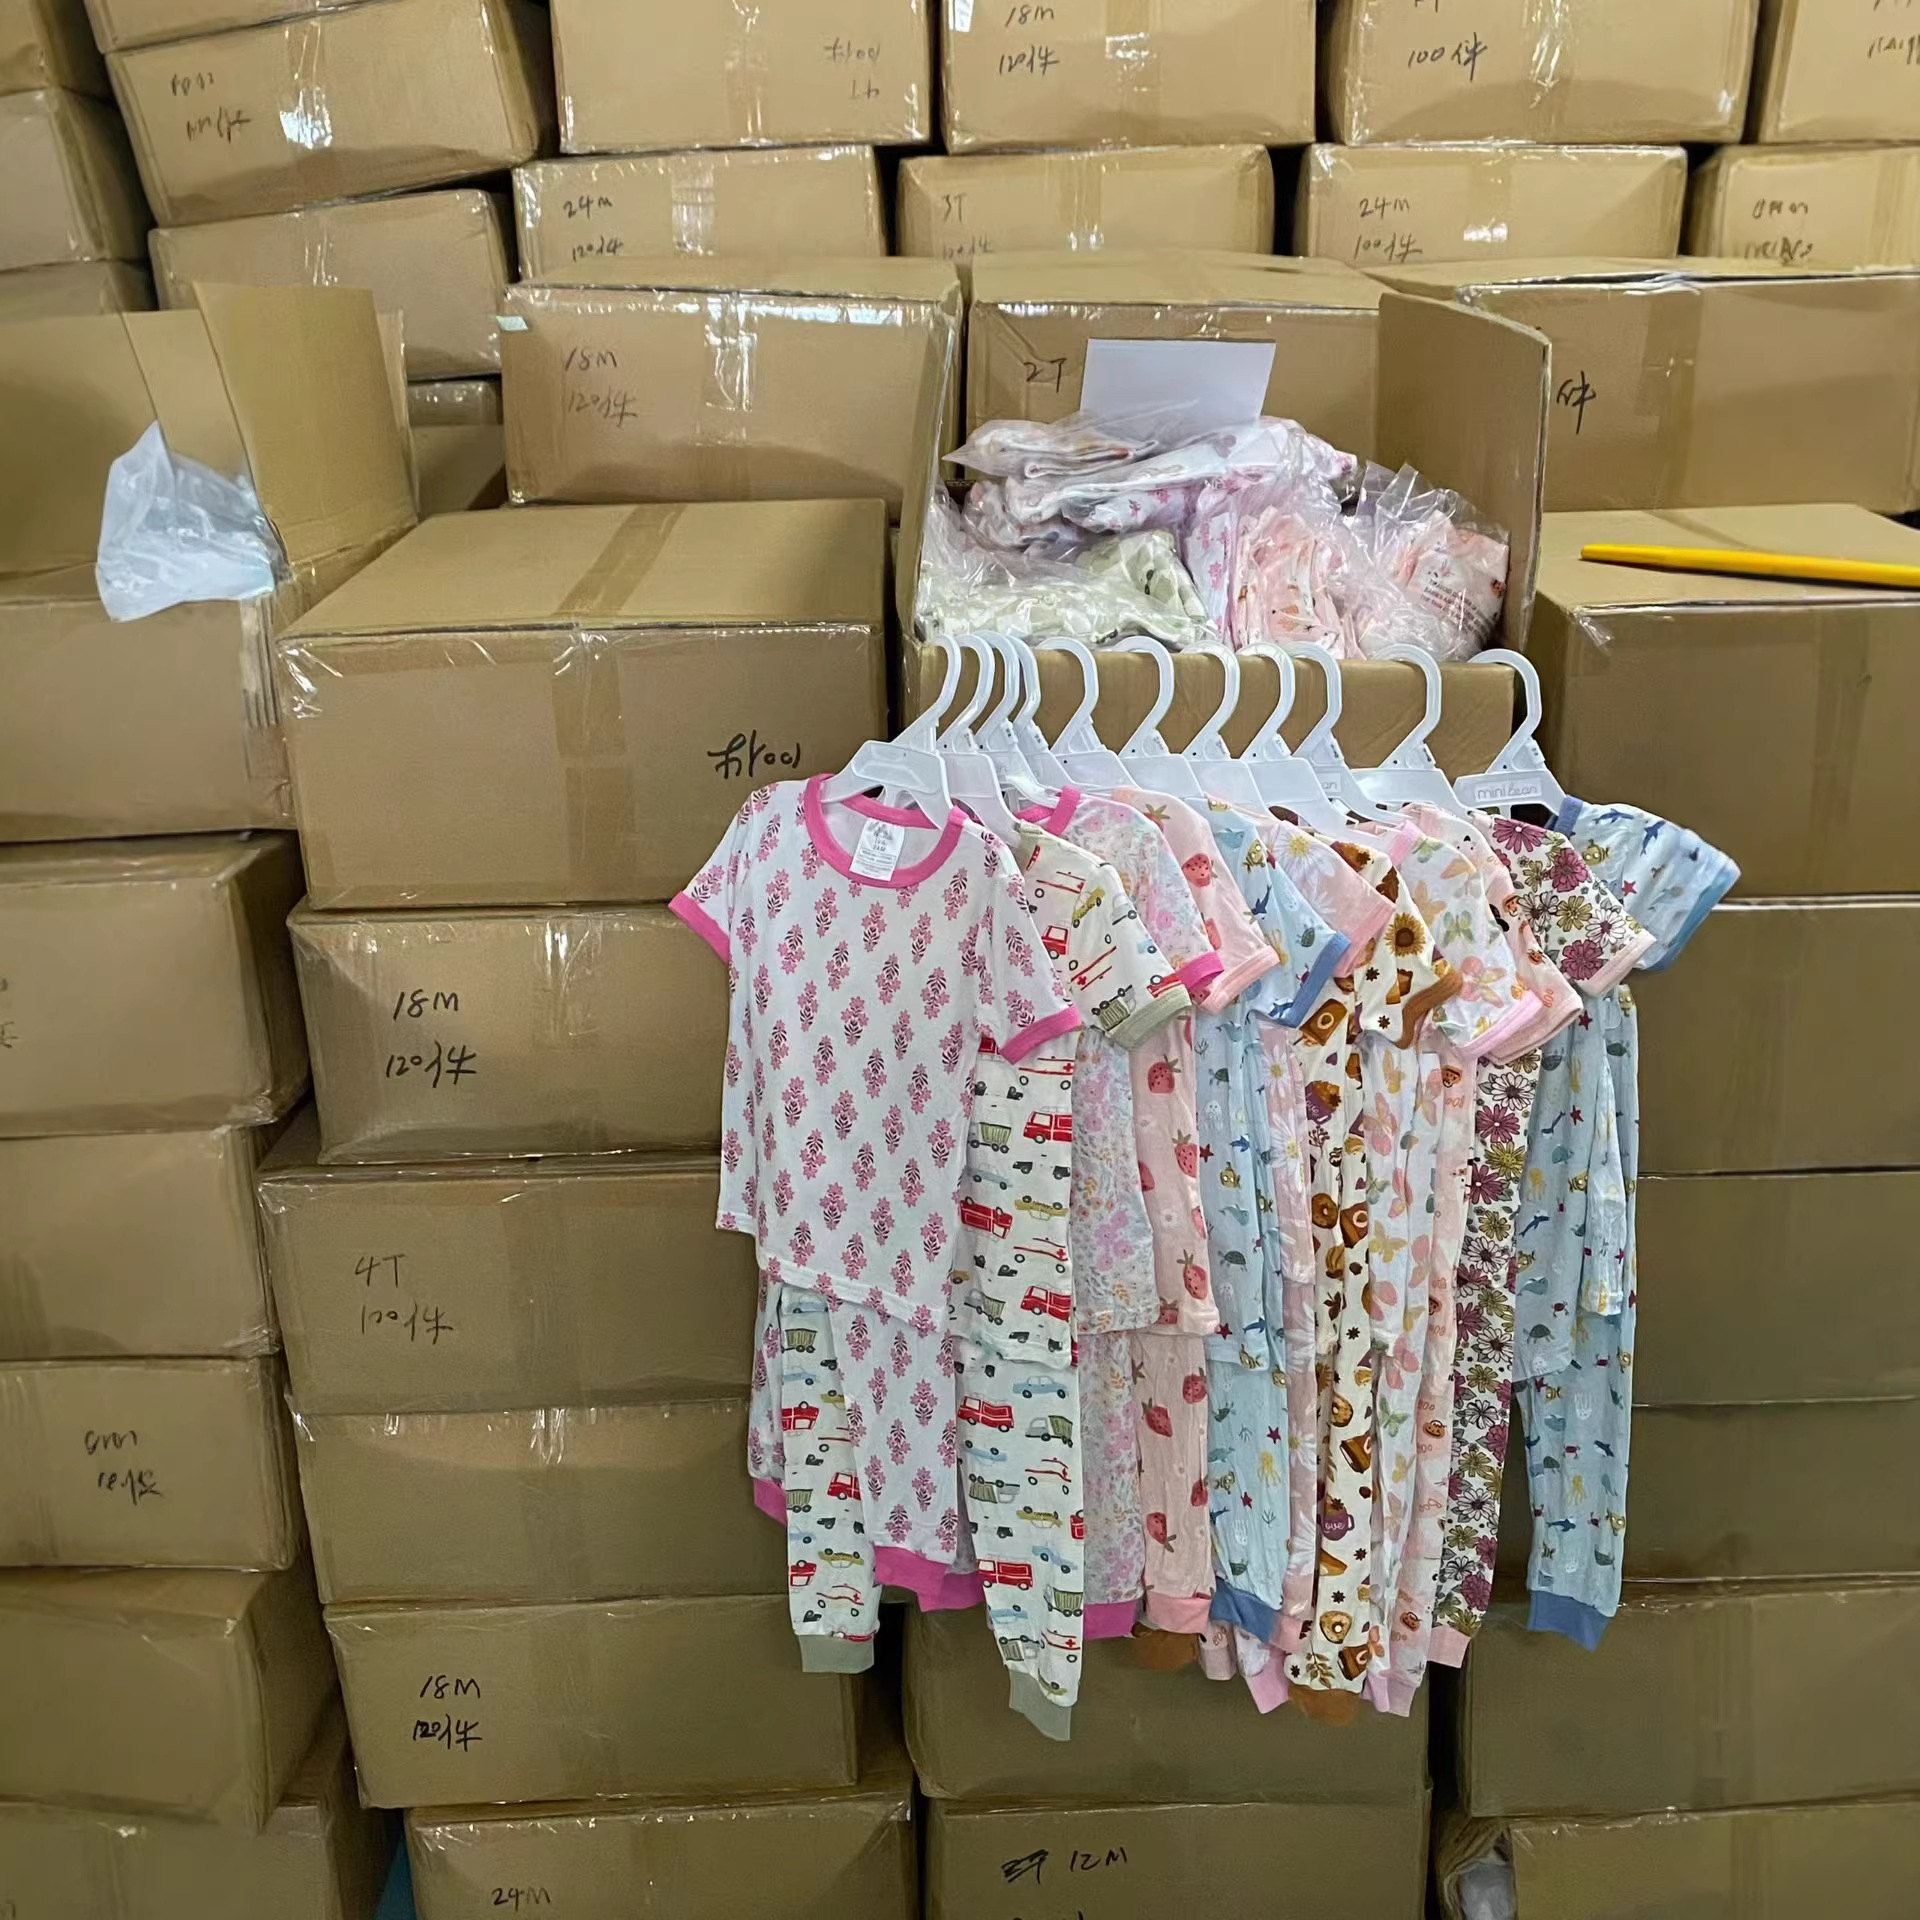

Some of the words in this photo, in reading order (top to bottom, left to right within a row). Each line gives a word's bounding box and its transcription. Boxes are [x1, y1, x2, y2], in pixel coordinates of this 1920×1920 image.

[393, 988, 459, 1021] 18M
[354, 1253, 406, 1289] 4T
[419, 1674, 481, 1699] 18M
[1069, 1846, 1128, 1872] 12M
